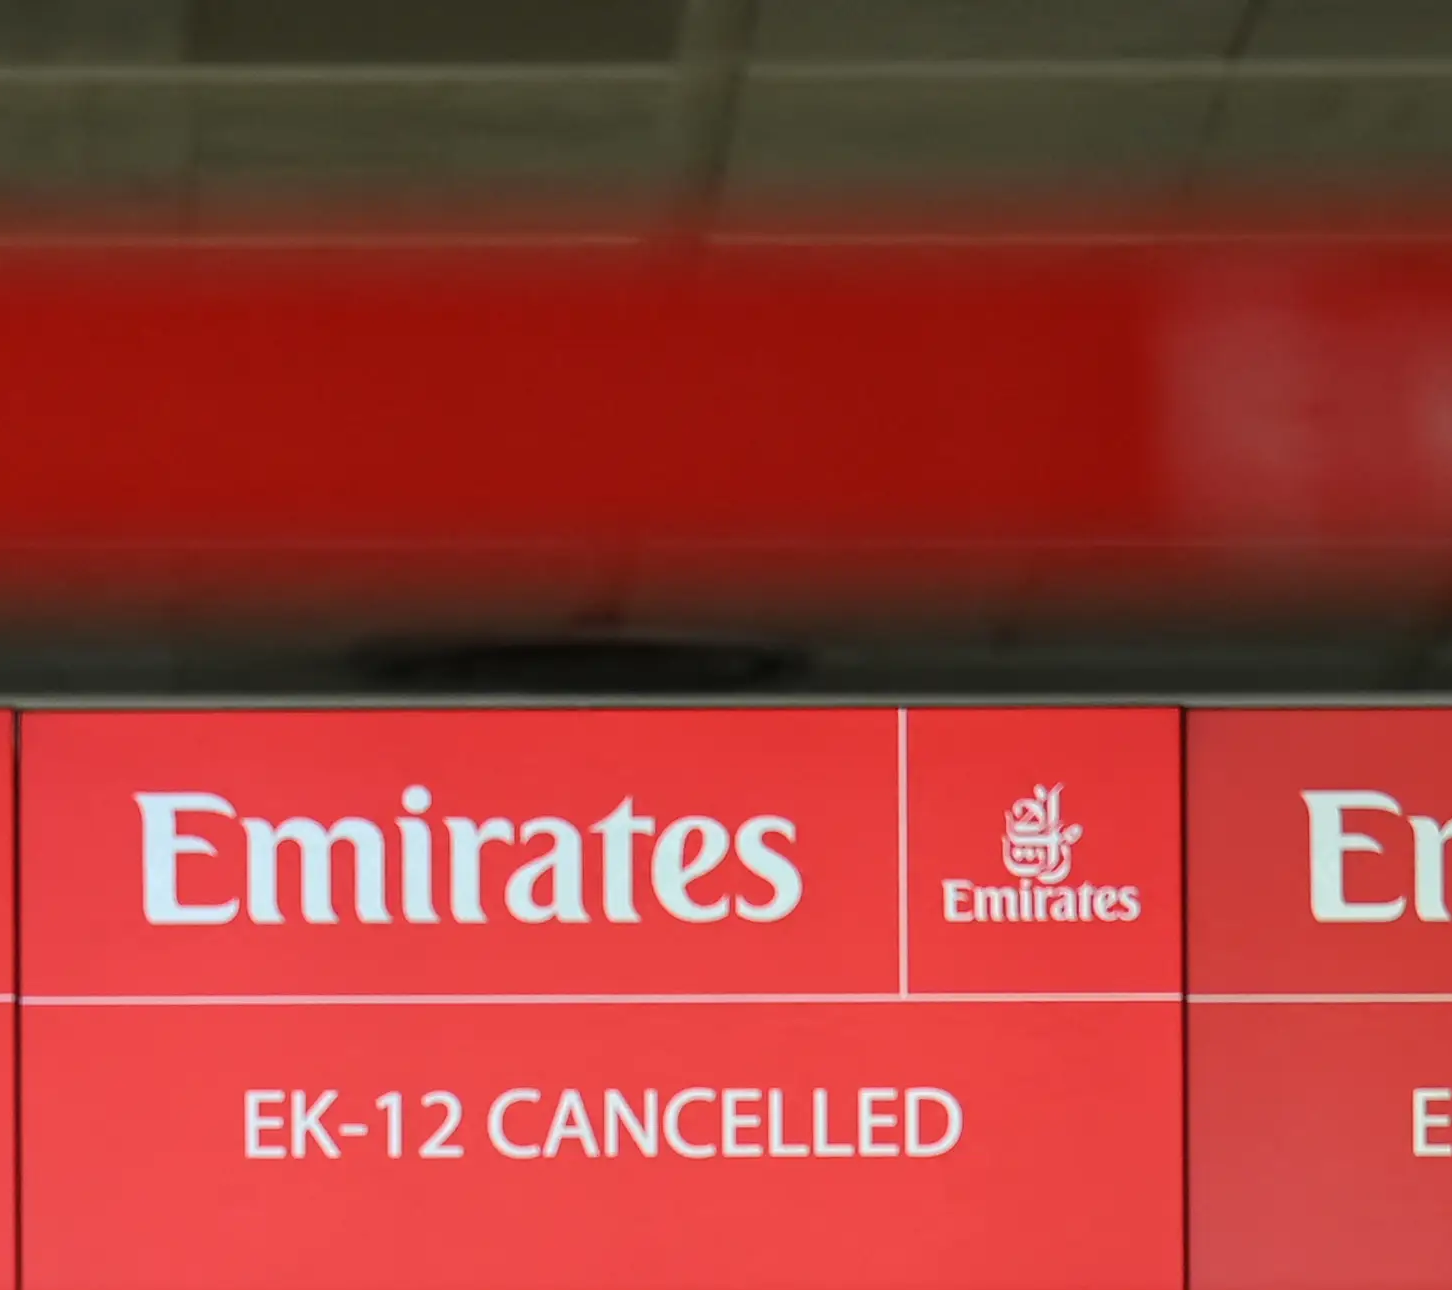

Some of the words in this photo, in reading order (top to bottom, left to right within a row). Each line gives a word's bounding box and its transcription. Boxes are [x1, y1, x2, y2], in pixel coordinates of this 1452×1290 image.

[135, 786, 802, 924] Emirates
[943, 878, 1140, 921] Emirates
[245, 1090, 463, 1158] EK-12
[488, 1088, 962, 1158] CANCELLED
